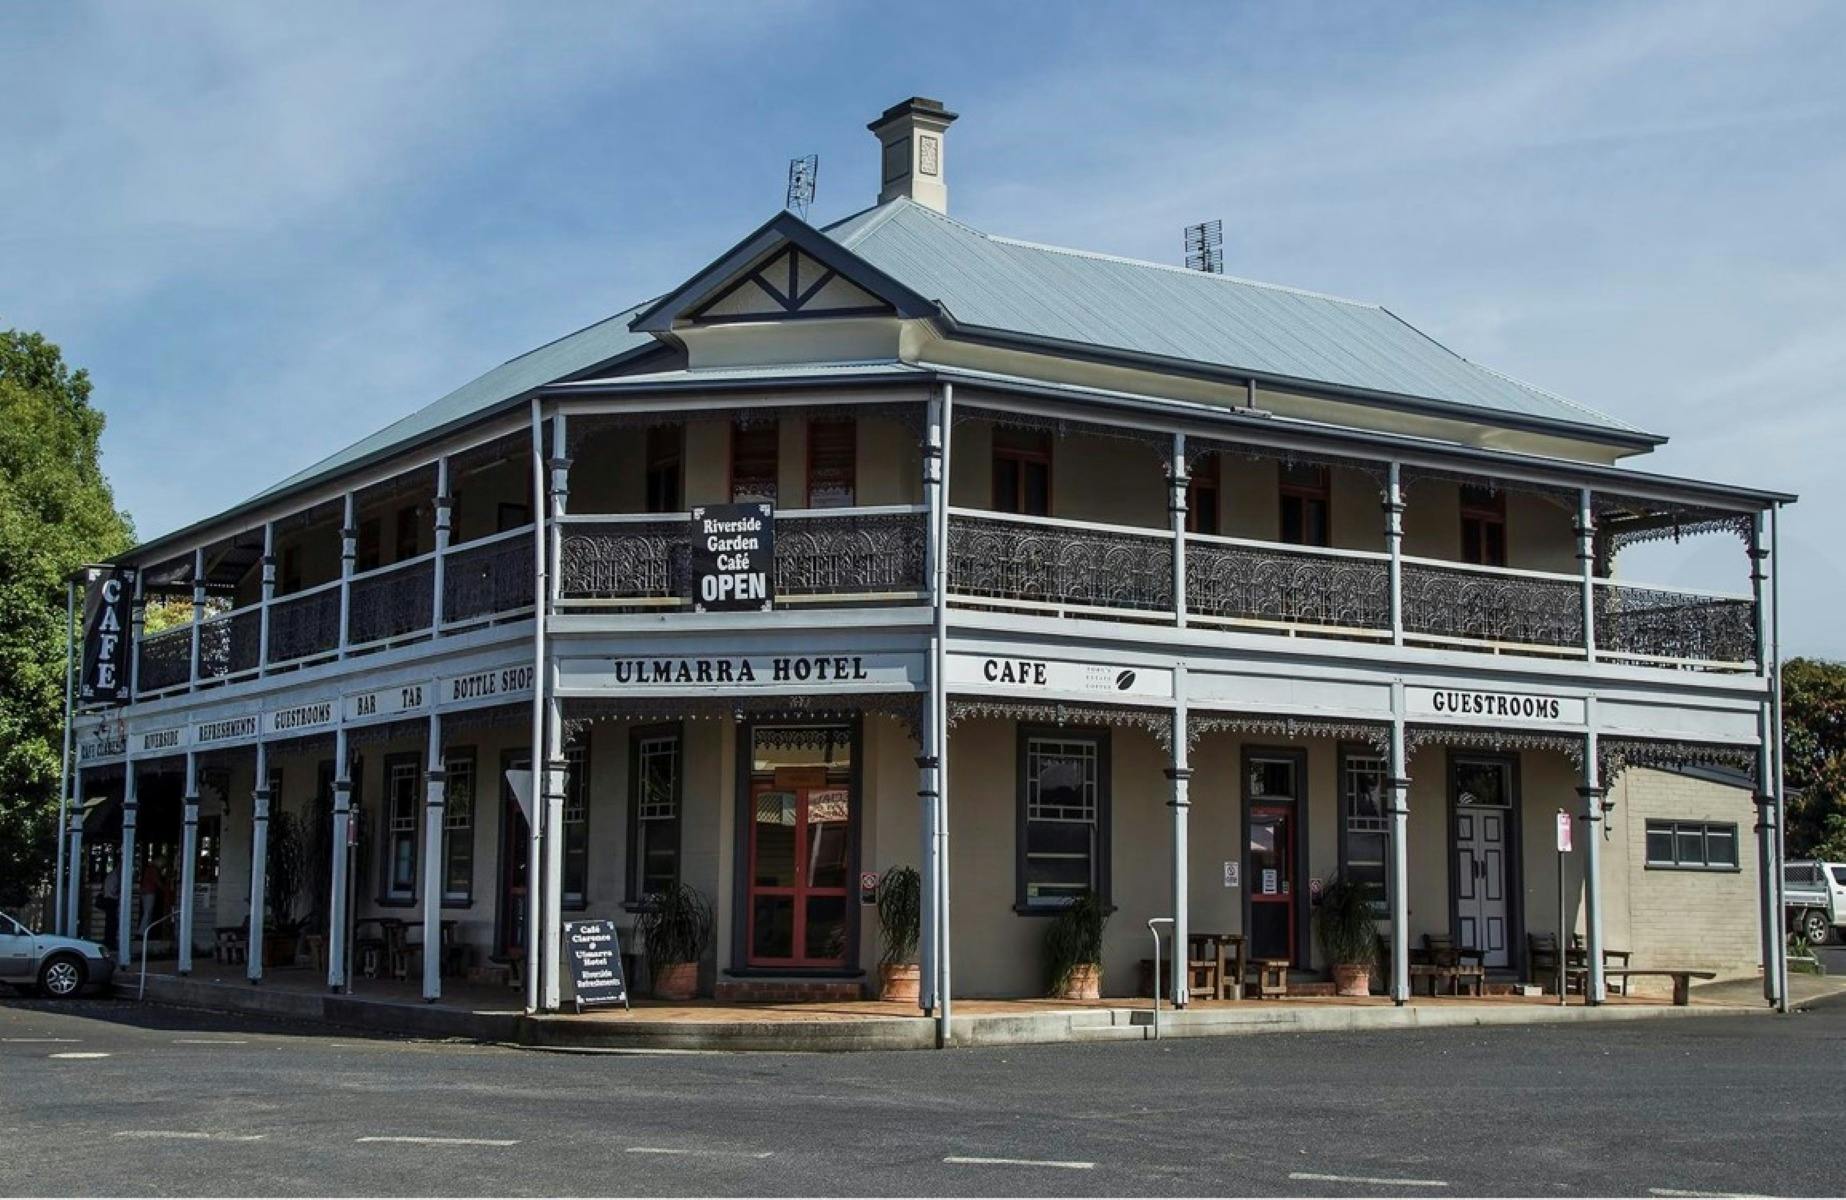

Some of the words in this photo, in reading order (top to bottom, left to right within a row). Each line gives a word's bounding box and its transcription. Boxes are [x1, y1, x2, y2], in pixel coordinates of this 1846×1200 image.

[703, 517, 762, 534] Riverside
[707, 535, 759, 552] Garden
[717, 552, 750, 571] Café
[702, 572, 766, 601] OPEN
[97, 579, 121, 689] CAFE
[453, 672, 496, 700] BOTTLE
[502, 666, 534, 692] SHOP
[614, 658, 757, 683] ULMARRA
[772, 657, 868, 682] HOTEL
[983, 659, 1047, 685] CAFE
[357, 695, 376, 716] BAR
[402, 686, 423, 708] TAB
[1432, 691, 1559, 719] GUESTROOMS
[199, 716, 256, 742] REFRESHMENTS
[274, 703, 332, 730] GUESTROOMS
[144, 730, 179, 750] RIVERSIDE
